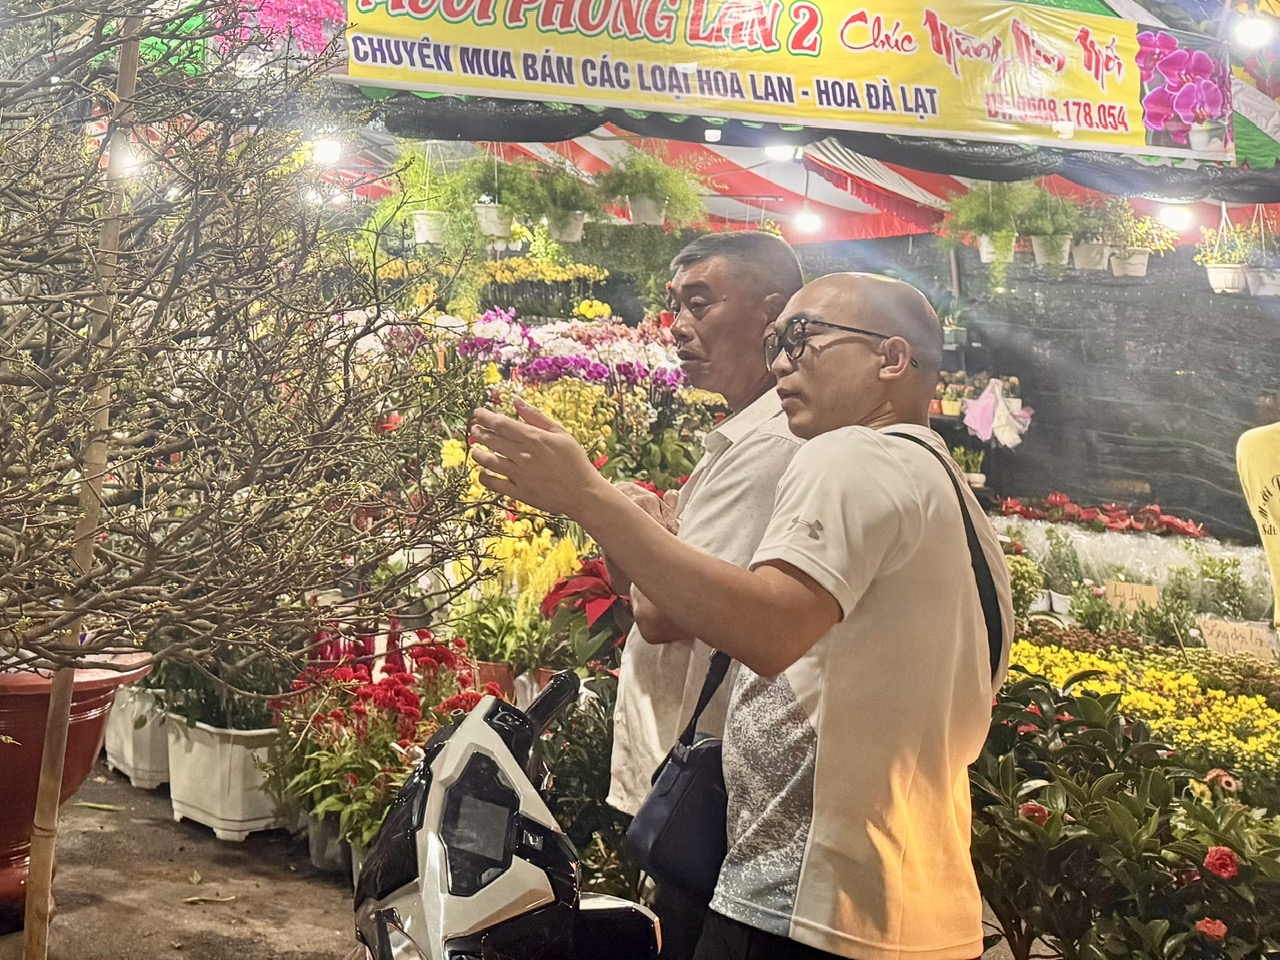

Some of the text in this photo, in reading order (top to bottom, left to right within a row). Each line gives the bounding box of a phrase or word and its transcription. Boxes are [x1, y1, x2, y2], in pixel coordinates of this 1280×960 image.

[790, 3, 820, 54] 2
[841, 11, 917, 53] Chúc
[352, 36, 451, 72] CHUYÊN
[459, 46, 516, 81] MUA
[523, 48, 575, 86] BÁN
[582, 53, 631, 90] CÁC
[637, 63, 691, 102] LOẠI
[696, 69, 746, 100] HOA
[749, 73, 795, 104] LAN
[816, 79, 861, 109] HOA
[866, 79, 897, 111] ĐÀ
[900, 85, 937, 120] LẠT
